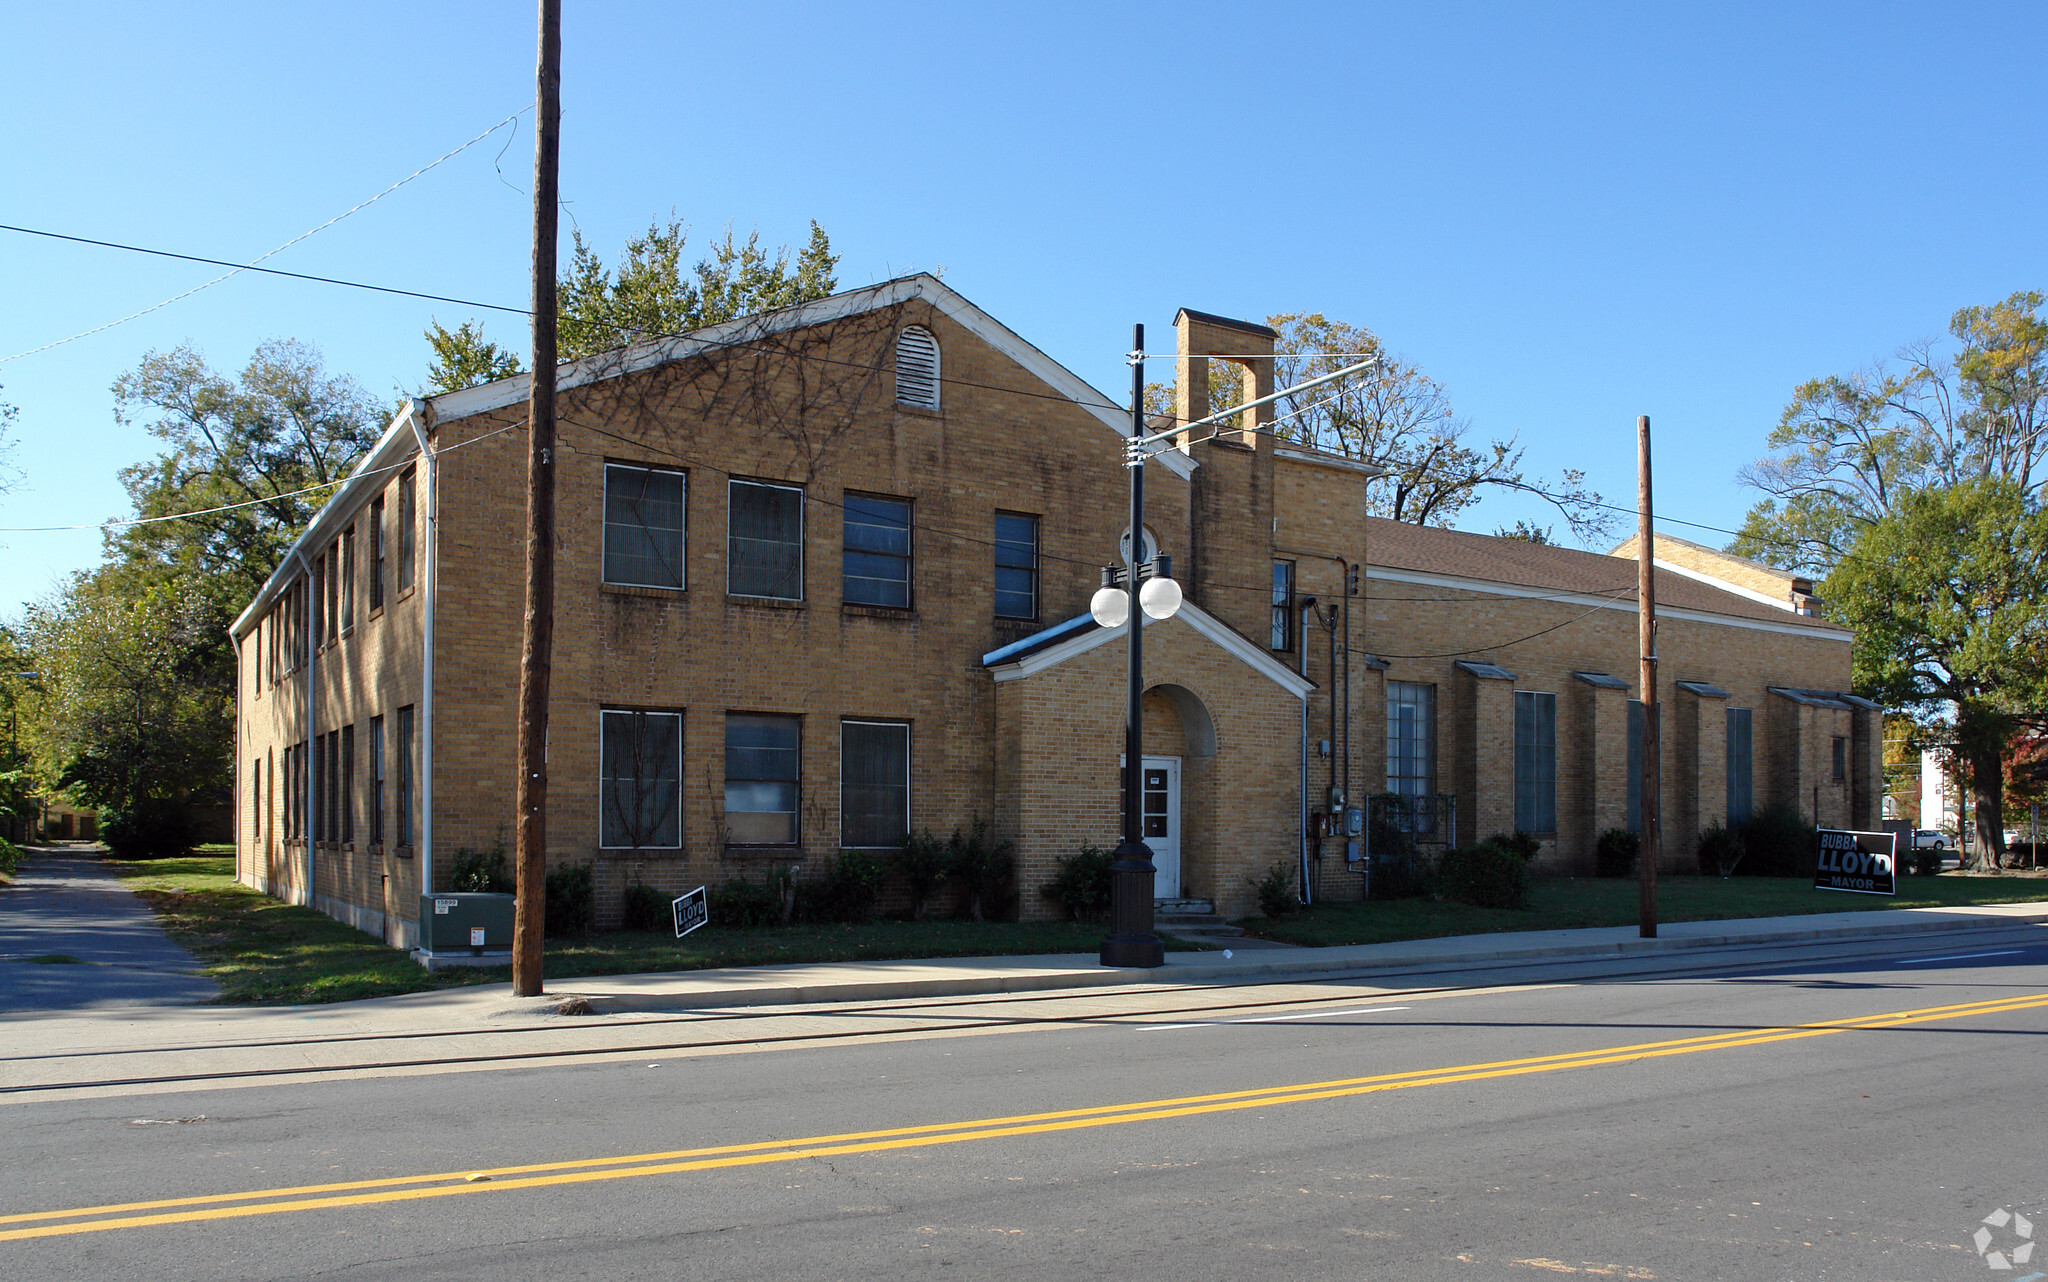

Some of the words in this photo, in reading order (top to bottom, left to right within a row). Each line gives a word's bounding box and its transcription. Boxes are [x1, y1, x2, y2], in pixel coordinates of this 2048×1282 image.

[1821, 833, 1857, 850] BUBBA
[1818, 849, 1891, 876] LLOYD
[1831, 876, 1874, 889] MAYOR
[678, 900, 704, 925] LLOYD
